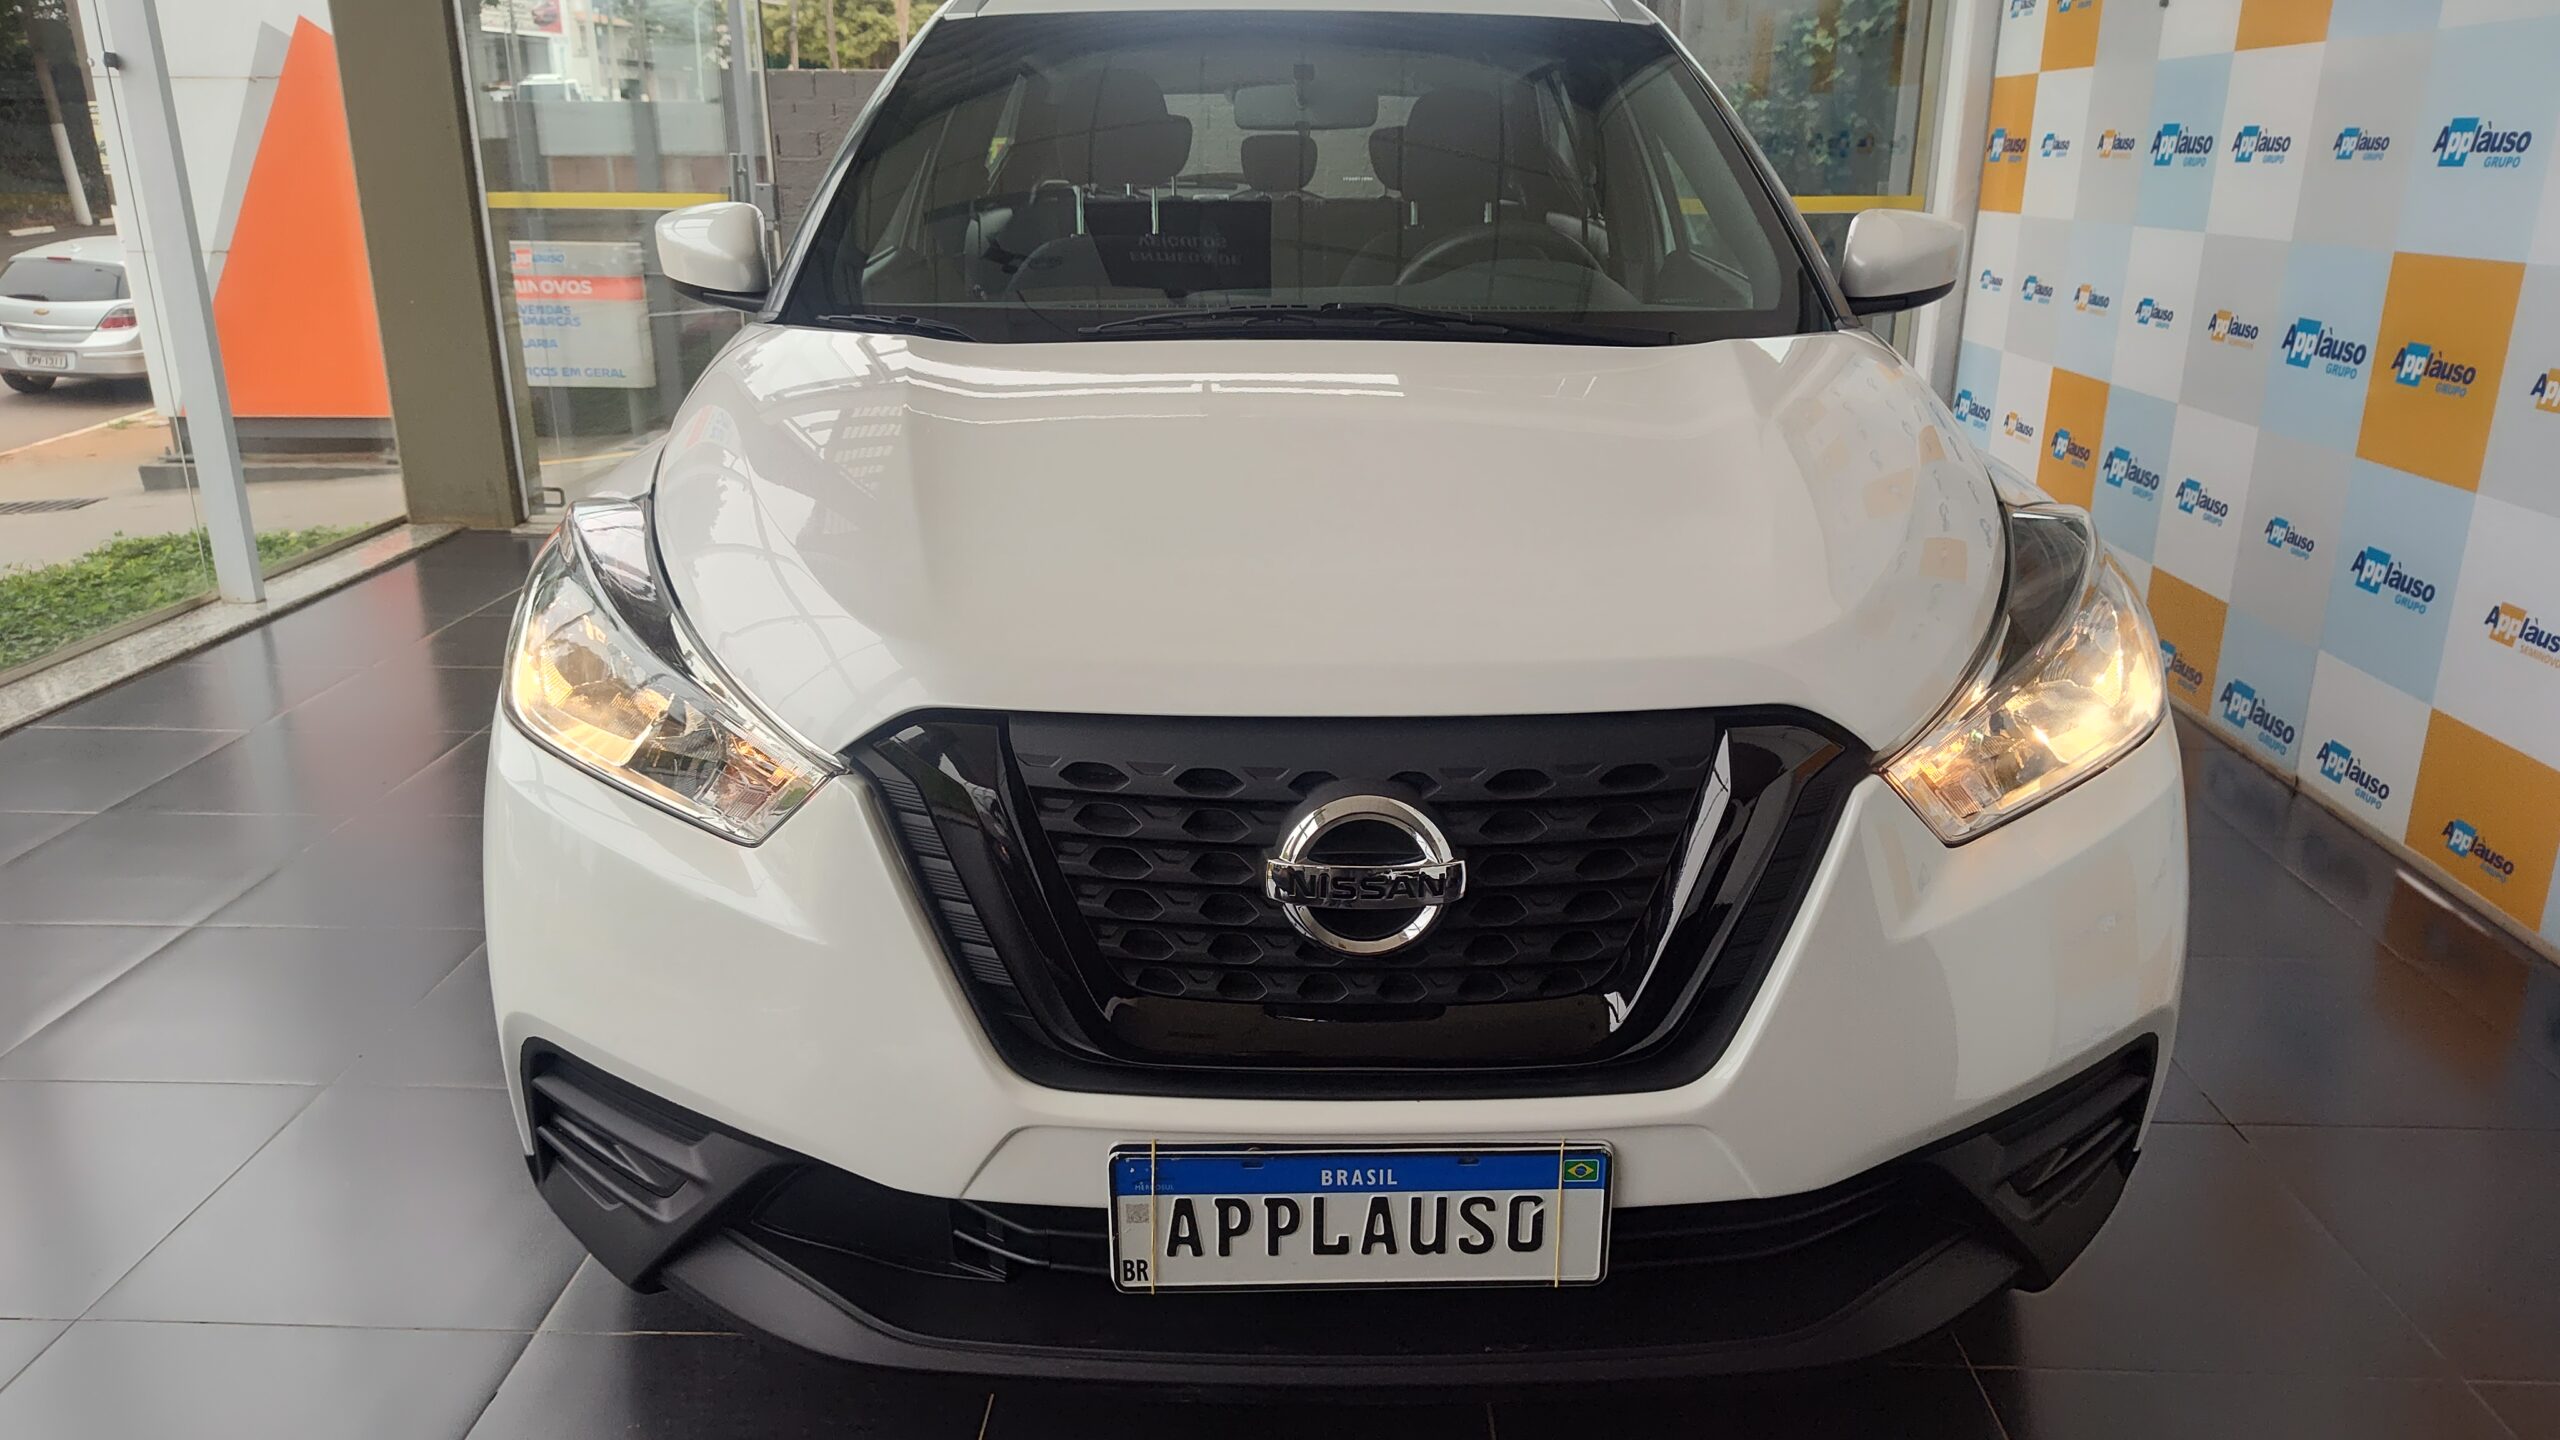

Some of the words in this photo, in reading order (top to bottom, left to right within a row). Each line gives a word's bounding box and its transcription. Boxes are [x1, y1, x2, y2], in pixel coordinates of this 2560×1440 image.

[2483, 156, 2521, 168] GRUPO
[2325, 363, 2358, 379] GRUPO
[2394, 593, 2426, 615] GRUPO
[2355, 787, 2382, 810] GRUPO
[1288, 866, 1447, 899] NISSAN
[1320, 1169, 1399, 1187] BRASIL
[1165, 1195, 1546, 1258] APPLAUSO
[1122, 1259, 1149, 1282] BR
